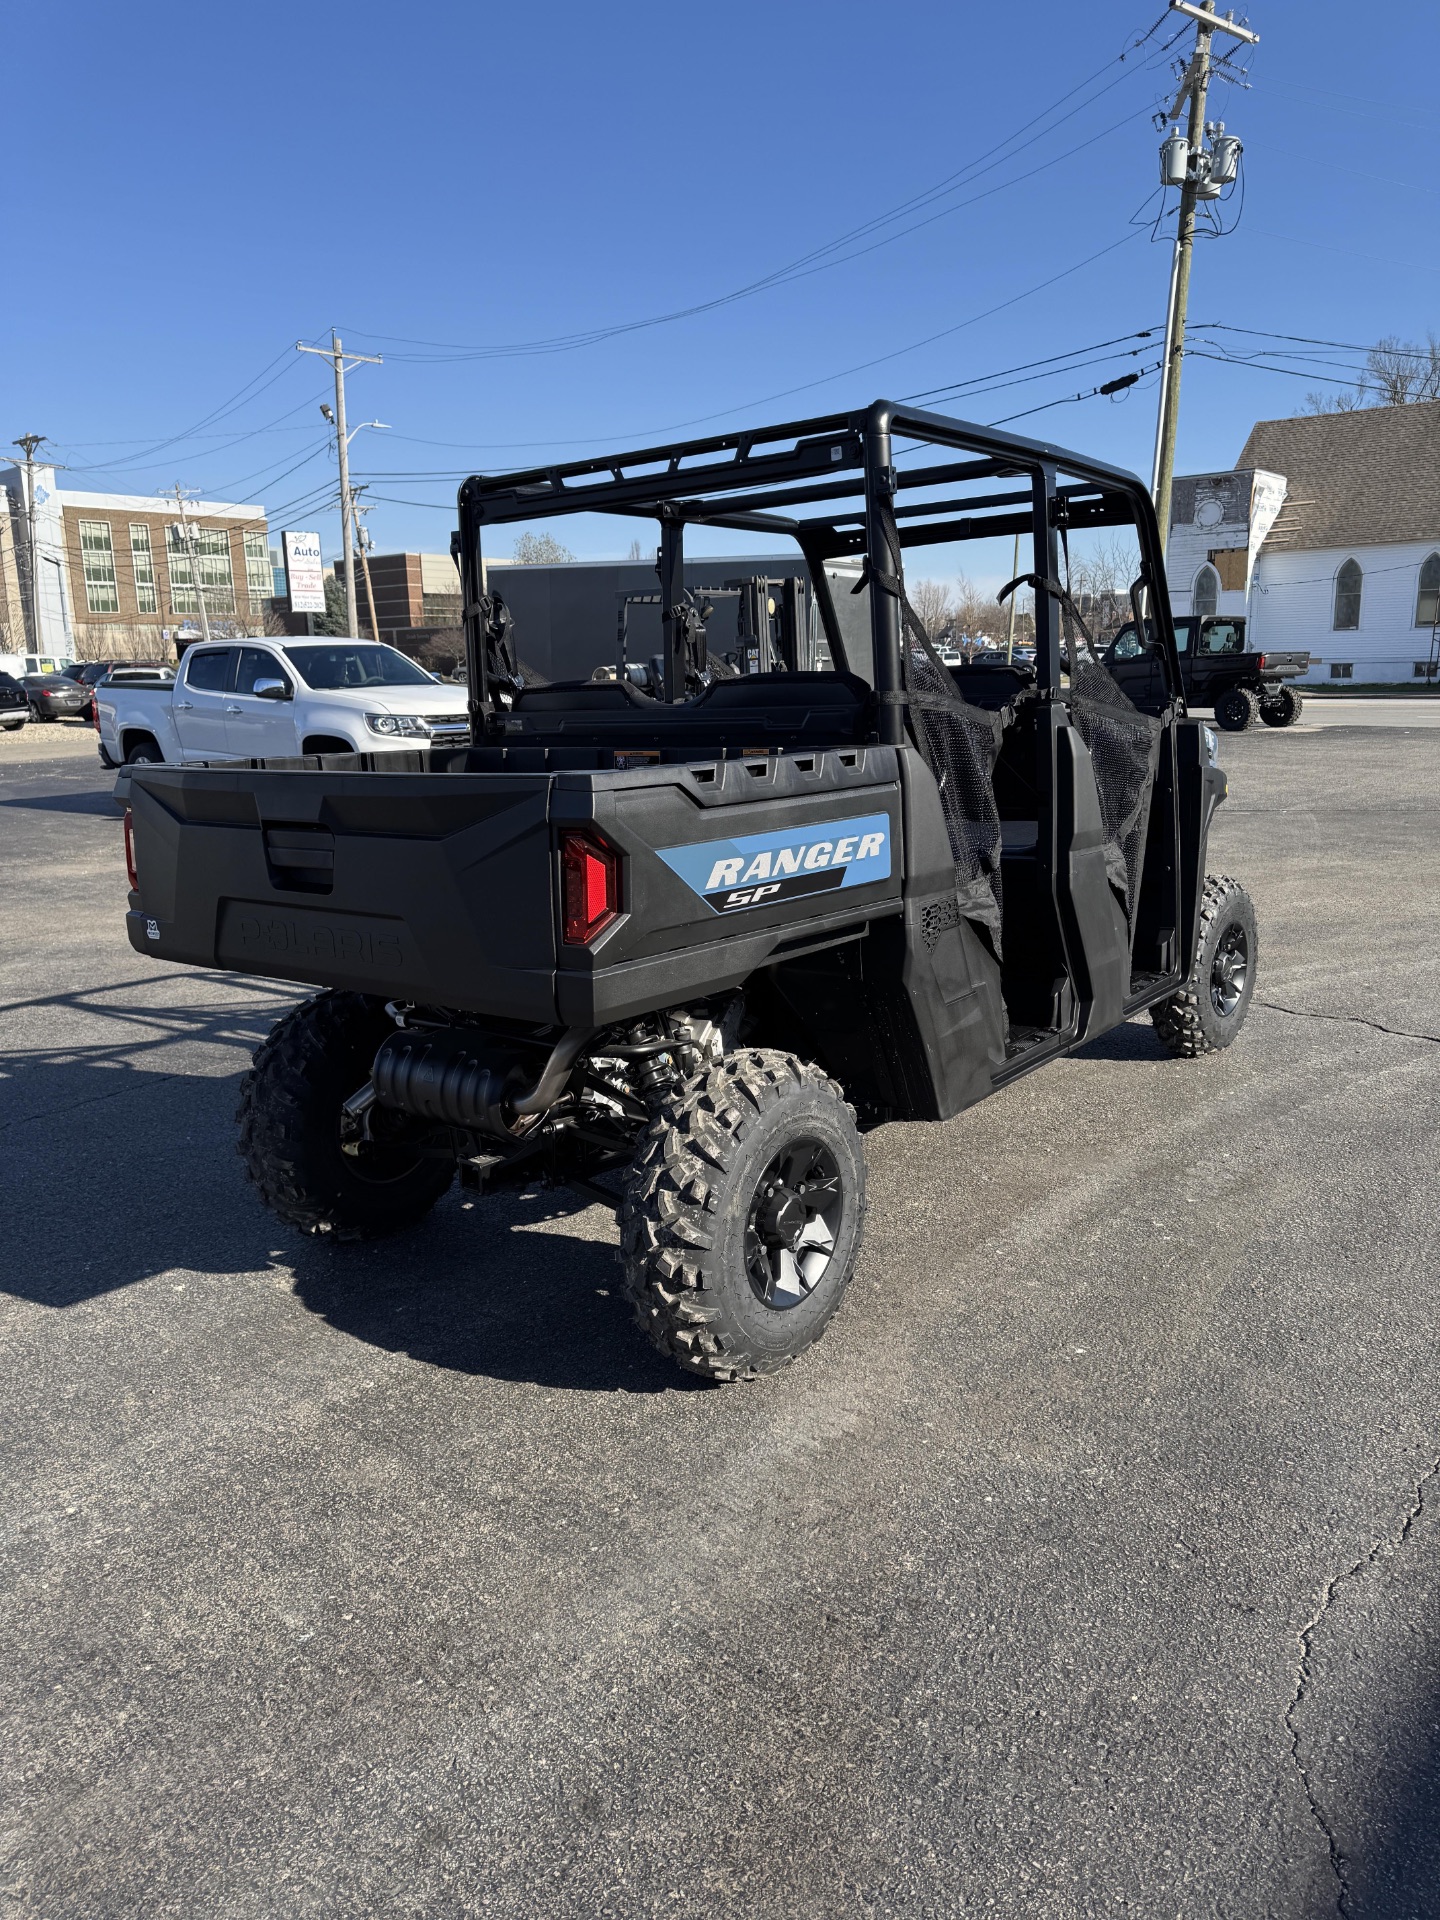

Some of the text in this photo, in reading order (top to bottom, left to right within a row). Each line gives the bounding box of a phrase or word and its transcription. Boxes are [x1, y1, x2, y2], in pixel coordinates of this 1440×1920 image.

[294, 546, 320, 557] Auto
[290, 573, 304, 581] Buy
[308, 573, 322, 581] Sell
[747, 649, 759, 659] CAT
[705, 832, 885, 889] RANGER
[723, 883, 781, 909] SP
[240, 916, 403, 967] POLARIS
